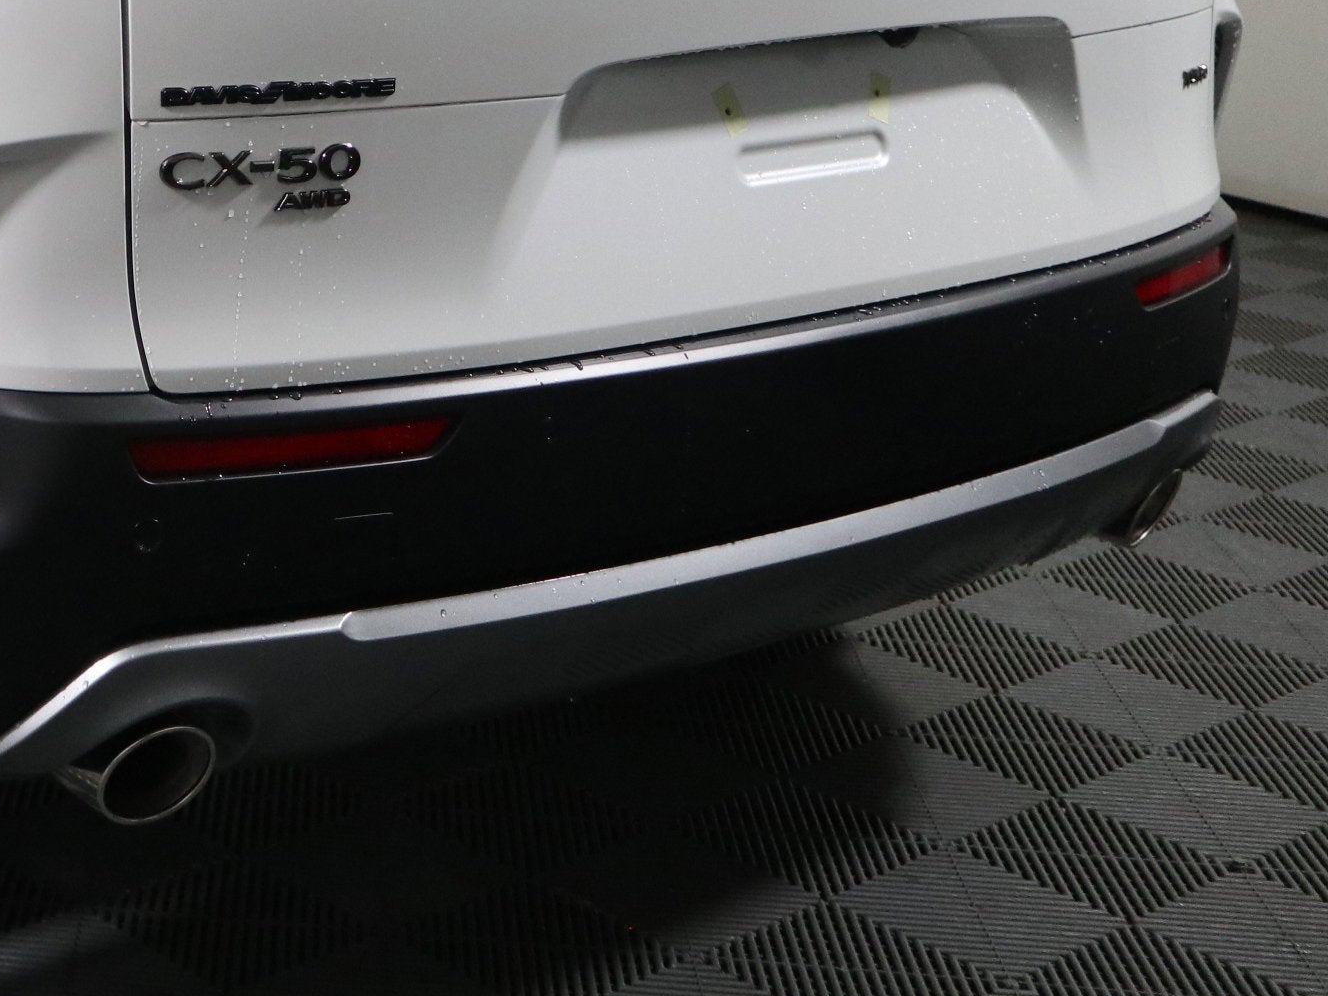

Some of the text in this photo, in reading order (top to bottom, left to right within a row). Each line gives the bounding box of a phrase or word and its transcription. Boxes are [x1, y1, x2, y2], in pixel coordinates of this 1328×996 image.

[160, 84, 264, 107] DAVIS
[159, 142, 362, 191] CX-50
[273, 187, 351, 212] AWD
